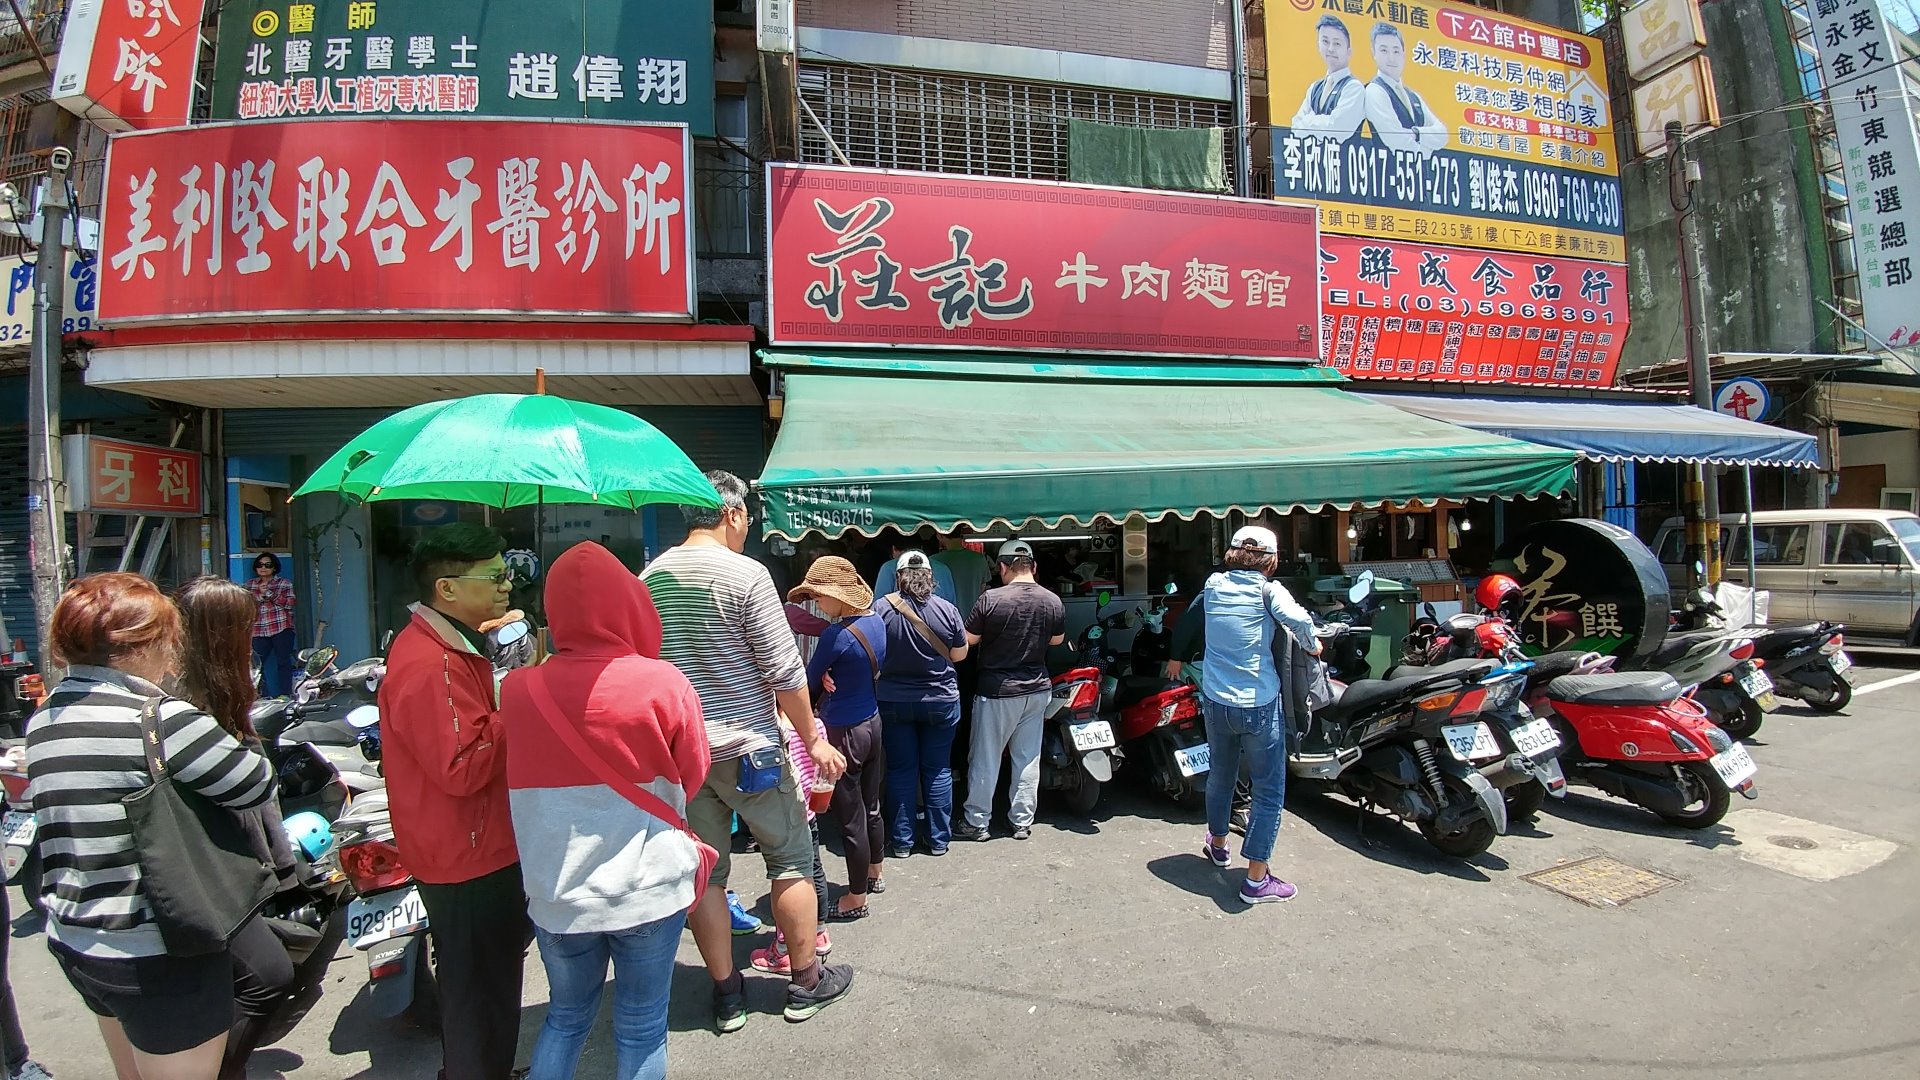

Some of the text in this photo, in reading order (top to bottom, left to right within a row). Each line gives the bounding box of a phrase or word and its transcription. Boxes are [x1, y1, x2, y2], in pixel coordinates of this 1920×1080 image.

[288, 1, 377, 34] 醫師
[1442, 12, 1583, 66] 下公館中豐店
[1846, 0, 1884, 68] 英文
[246, 35, 479, 77] 北醫牙醫學士
[509, 52, 688, 106] 趙偉翔
[1413, 43, 1566, 94] 永慶科技房仲網
[239, 75, 479, 119] 紐約大學人工植牙專科醫師
[1456, 83, 1600, 128] 找尋您夢想的家
[1459, 128, 1605, 167] 歡迎看屋 委賣介紹
[1474, 112, 1589, 144] 成交快速 精準配對
[1348, 145, 1460, 206] 0917-551-273
[1524, 173, 1619, 228] 0960-760-330
[1854, 84, 1912, 288] 竹東競選總部
[1055, 251, 1291, 309] 牛肉麵館
[1333, 315, 1358, 369] 訂婚喜餅
[1355, 317, 1380, 370] 結婚米糕
[1439, 322, 1464, 374] 敬神貢品
[1534, 328, 1560, 378] 罐頭塔
[1552, 330, 1577, 380] 古早味童玩
[1570, 331, 1595, 380] 抽抽樂
[1586, 333, 1612, 381] 洞洞樂
[100, 450, 190, 504] 牙科
[786, 508, 874, 529] TEL:5968715
[375, 947, 405, 960] KYMCO
